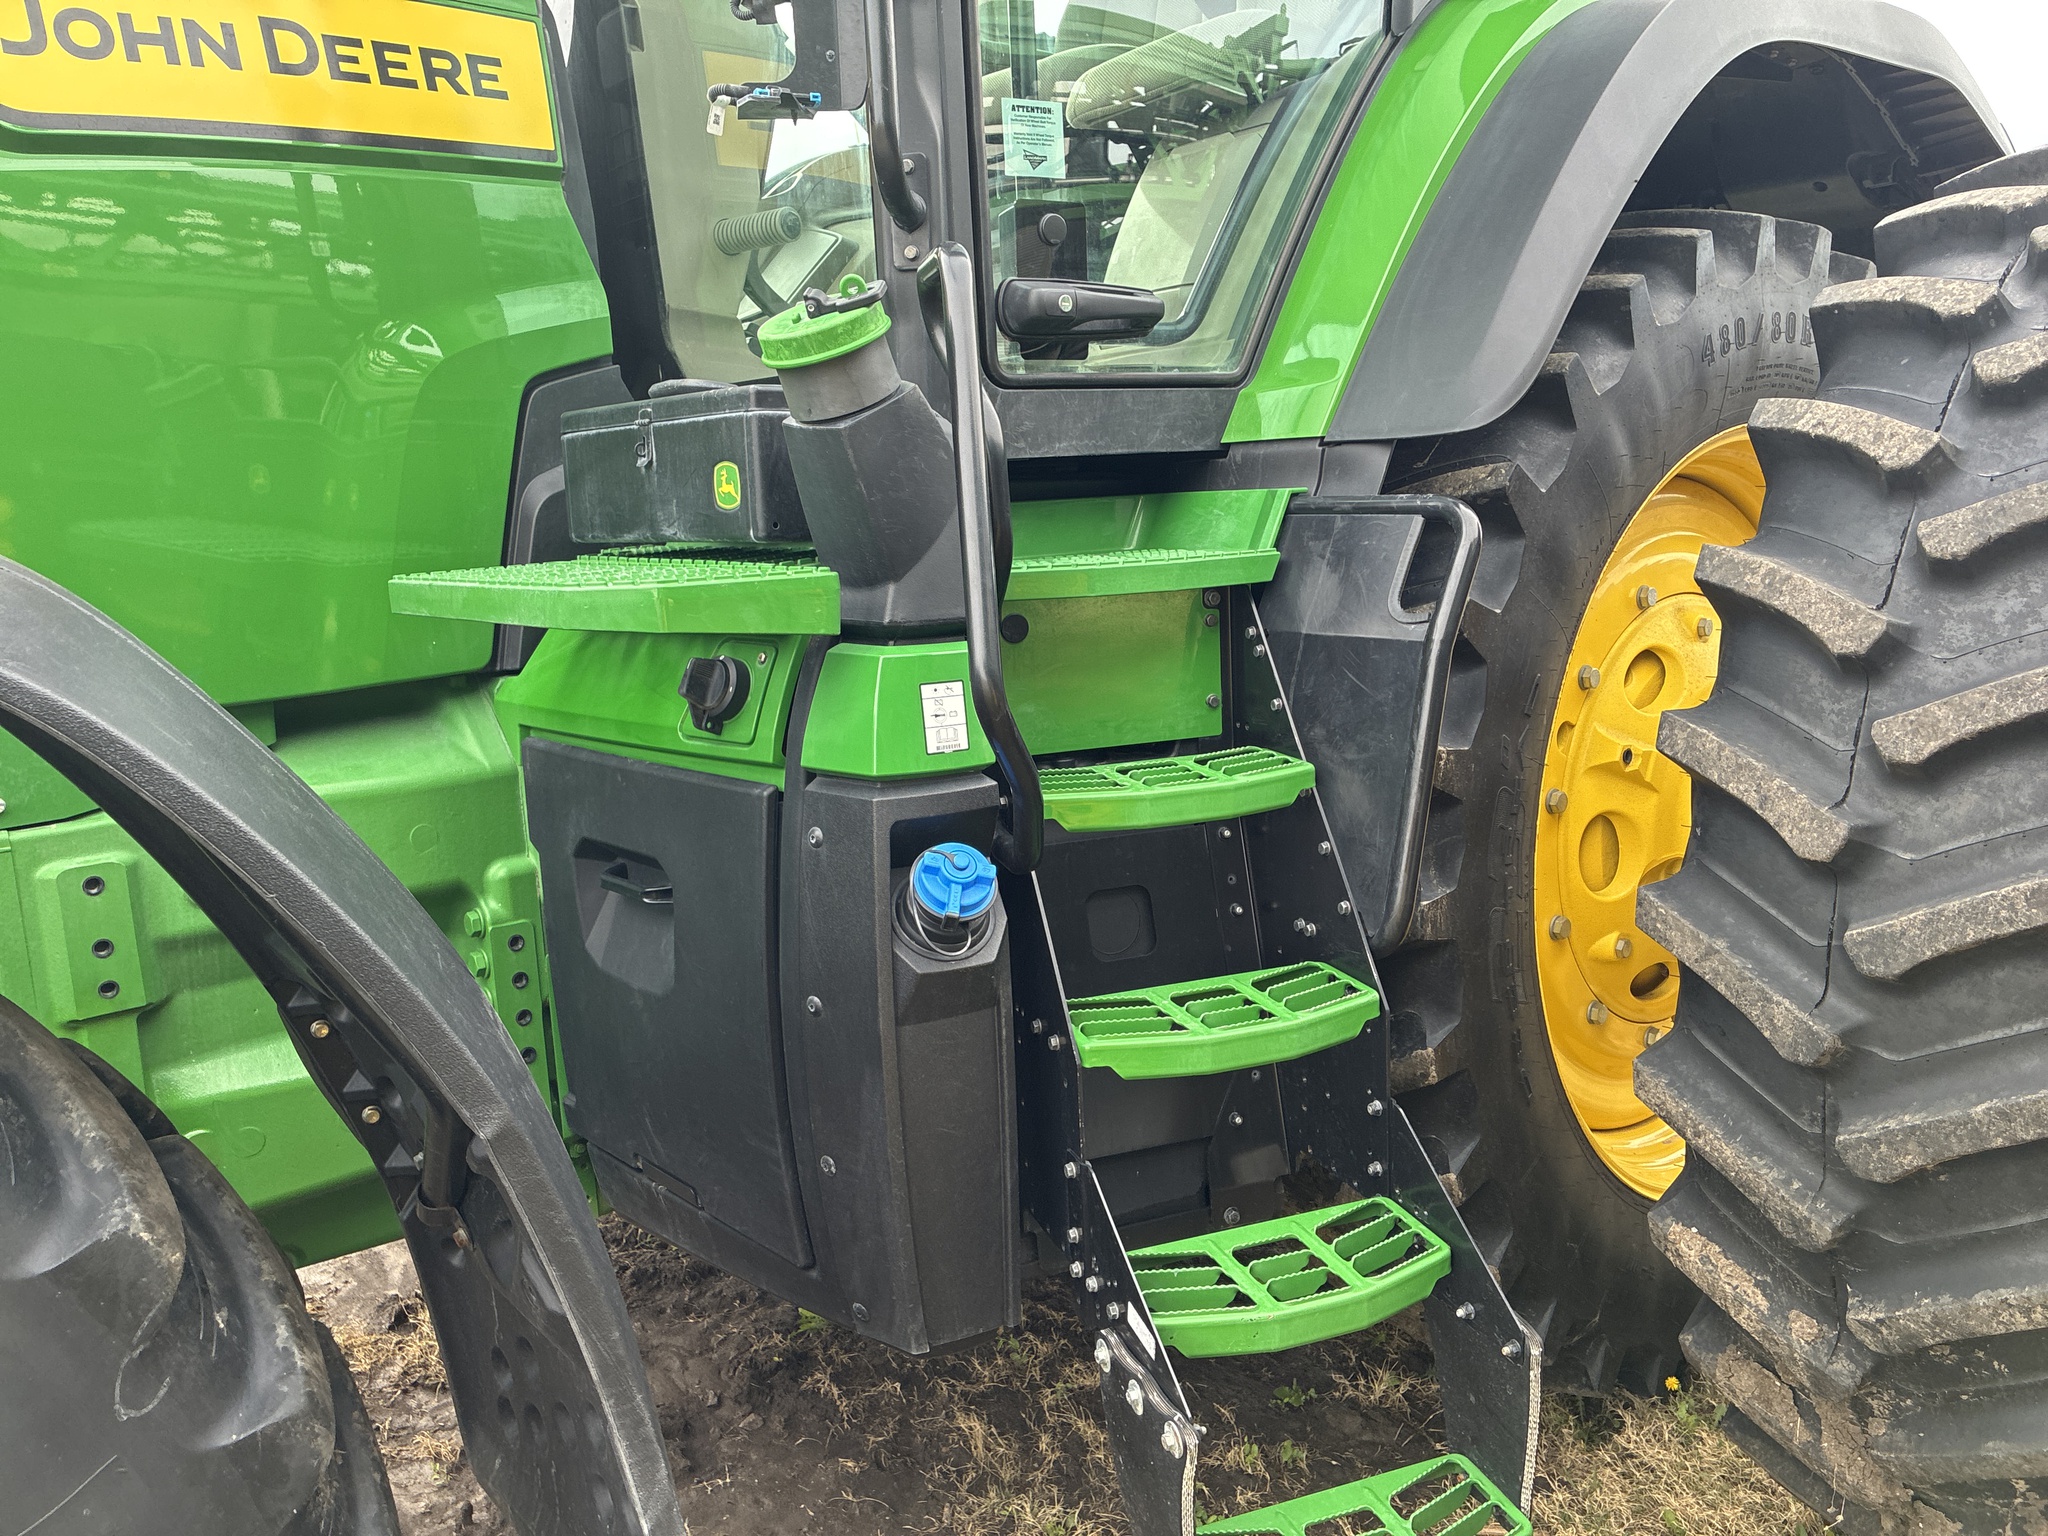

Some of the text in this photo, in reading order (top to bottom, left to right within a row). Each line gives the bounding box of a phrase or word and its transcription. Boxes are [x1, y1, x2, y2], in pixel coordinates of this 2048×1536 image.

[1, 0, 510, 101] JOHN DEERE
[1011, 104, 1055, 115] ATTENTION:
